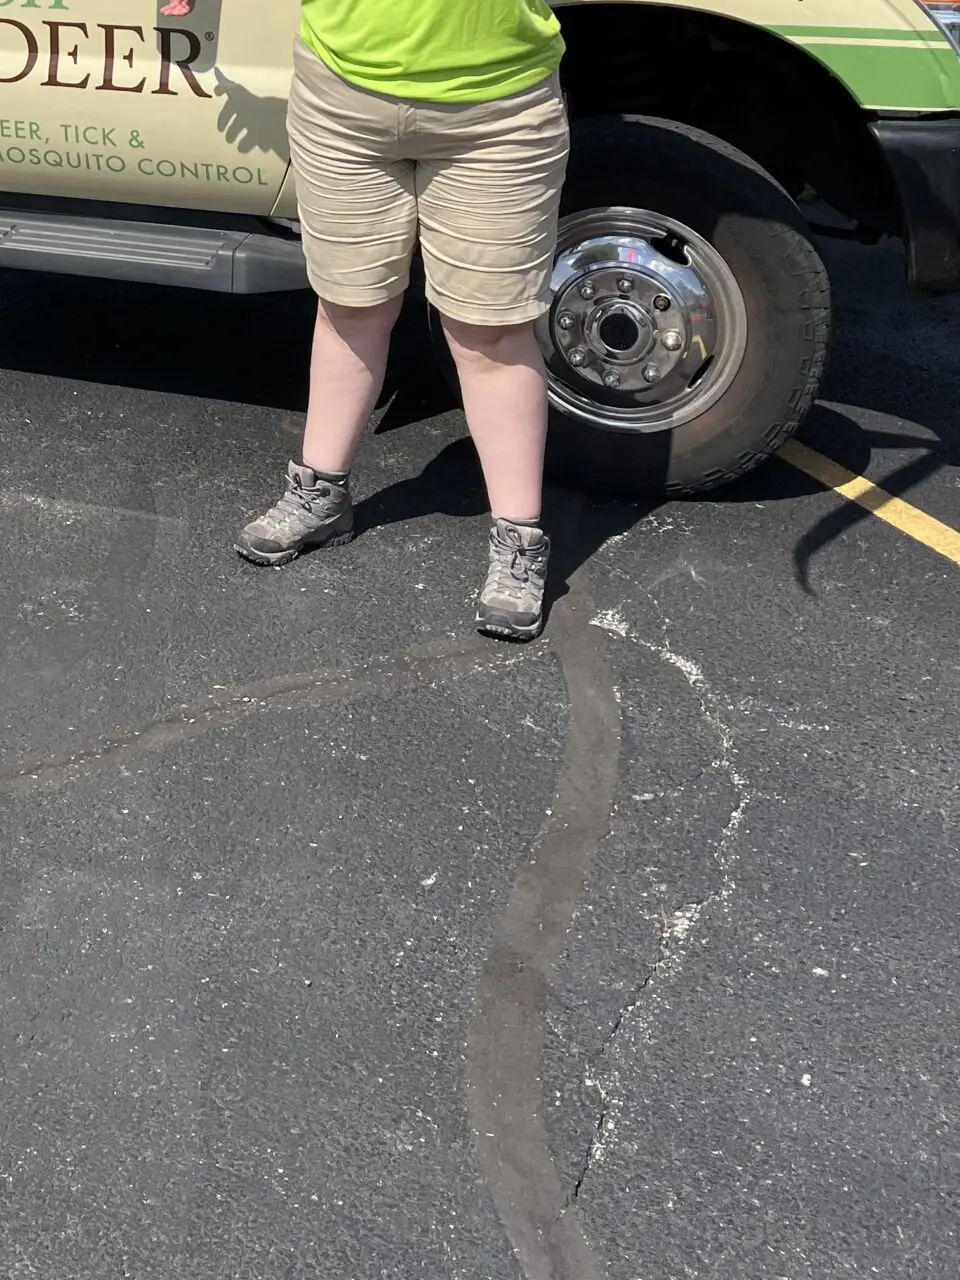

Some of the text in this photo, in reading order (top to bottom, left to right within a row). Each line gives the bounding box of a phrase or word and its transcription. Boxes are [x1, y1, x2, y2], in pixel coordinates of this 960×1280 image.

[59, 123, 118, 148] TICK
[128, 129, 146, 149] &
[137, 157, 269, 186] CONTROL
